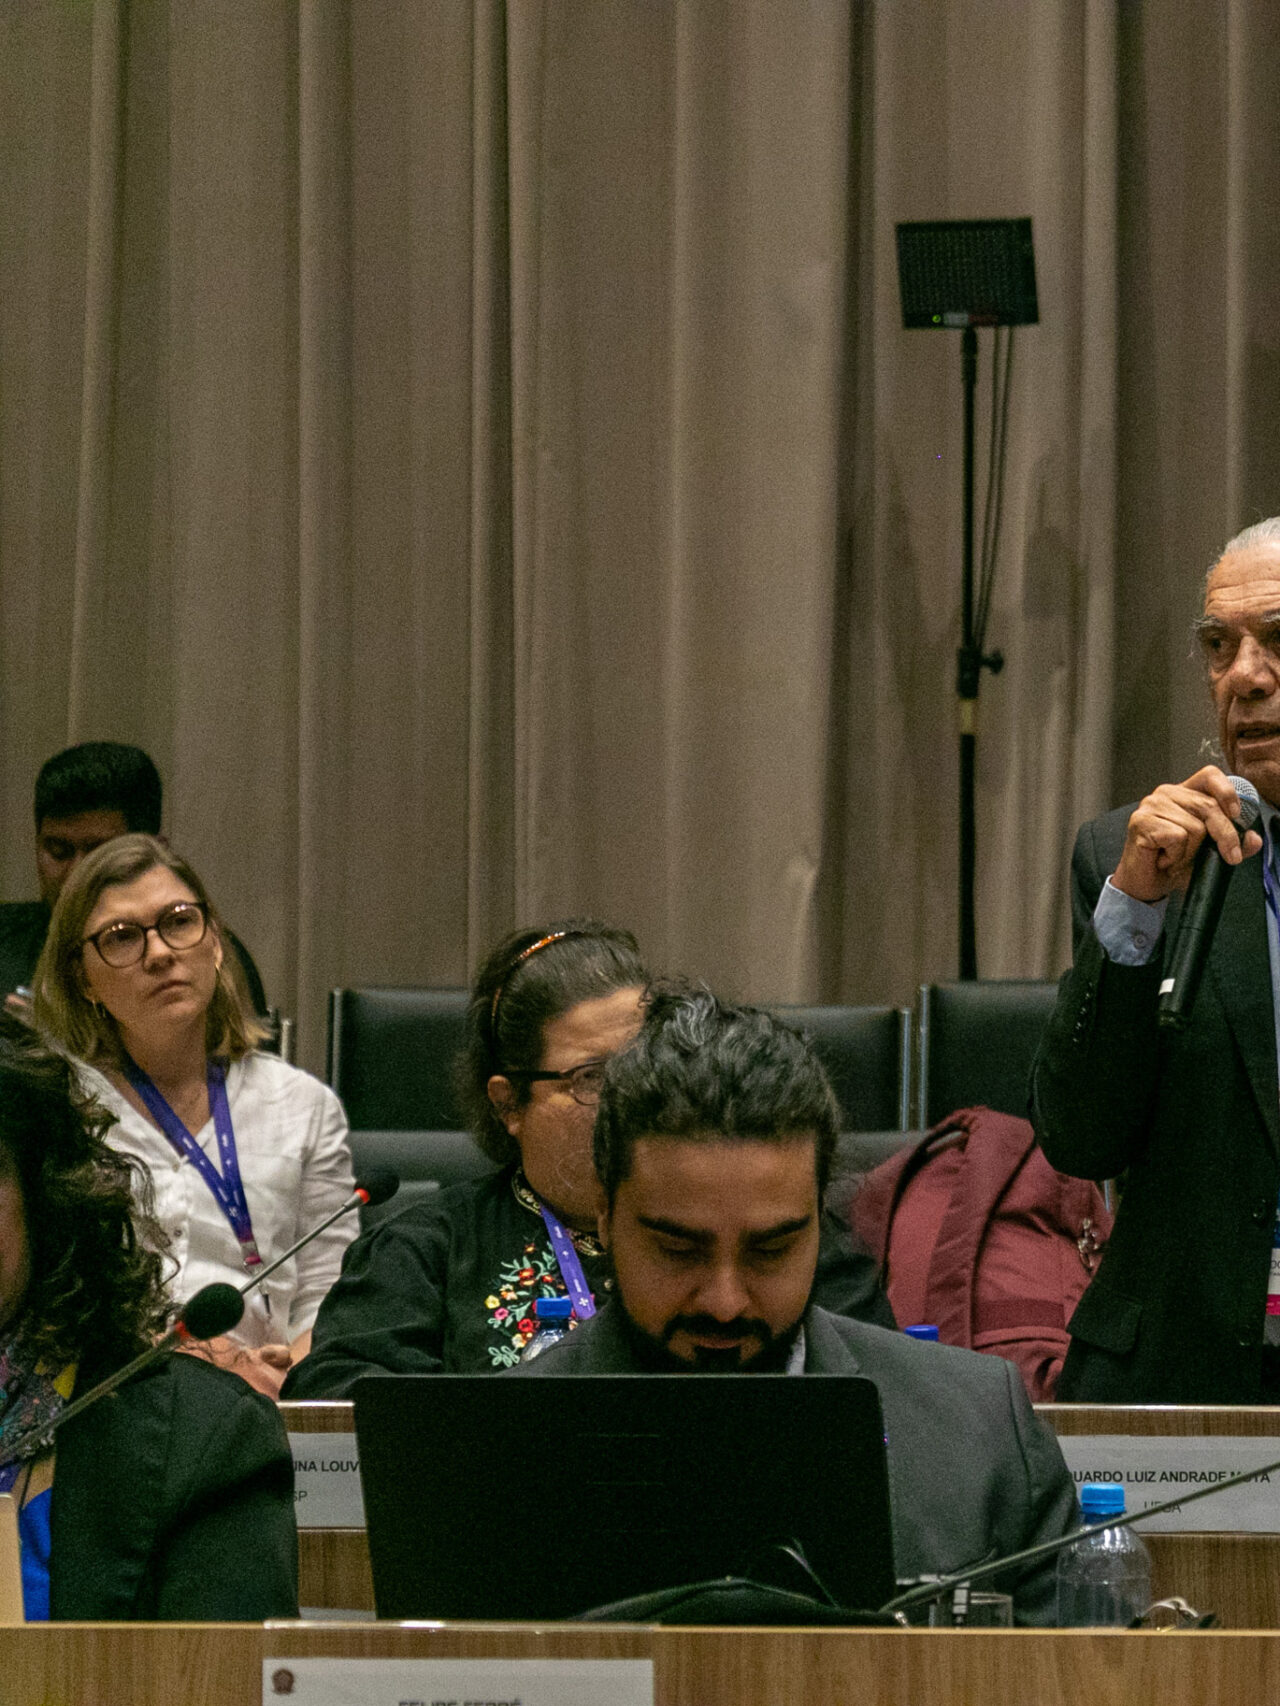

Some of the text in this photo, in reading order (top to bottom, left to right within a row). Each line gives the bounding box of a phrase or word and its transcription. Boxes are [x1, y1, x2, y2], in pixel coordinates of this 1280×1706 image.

[1071, 1470, 1123, 1483] UARDO
[1126, 1470, 1157, 1483] LUIZ
[1230, 1470, 1271, 1483] MTA
